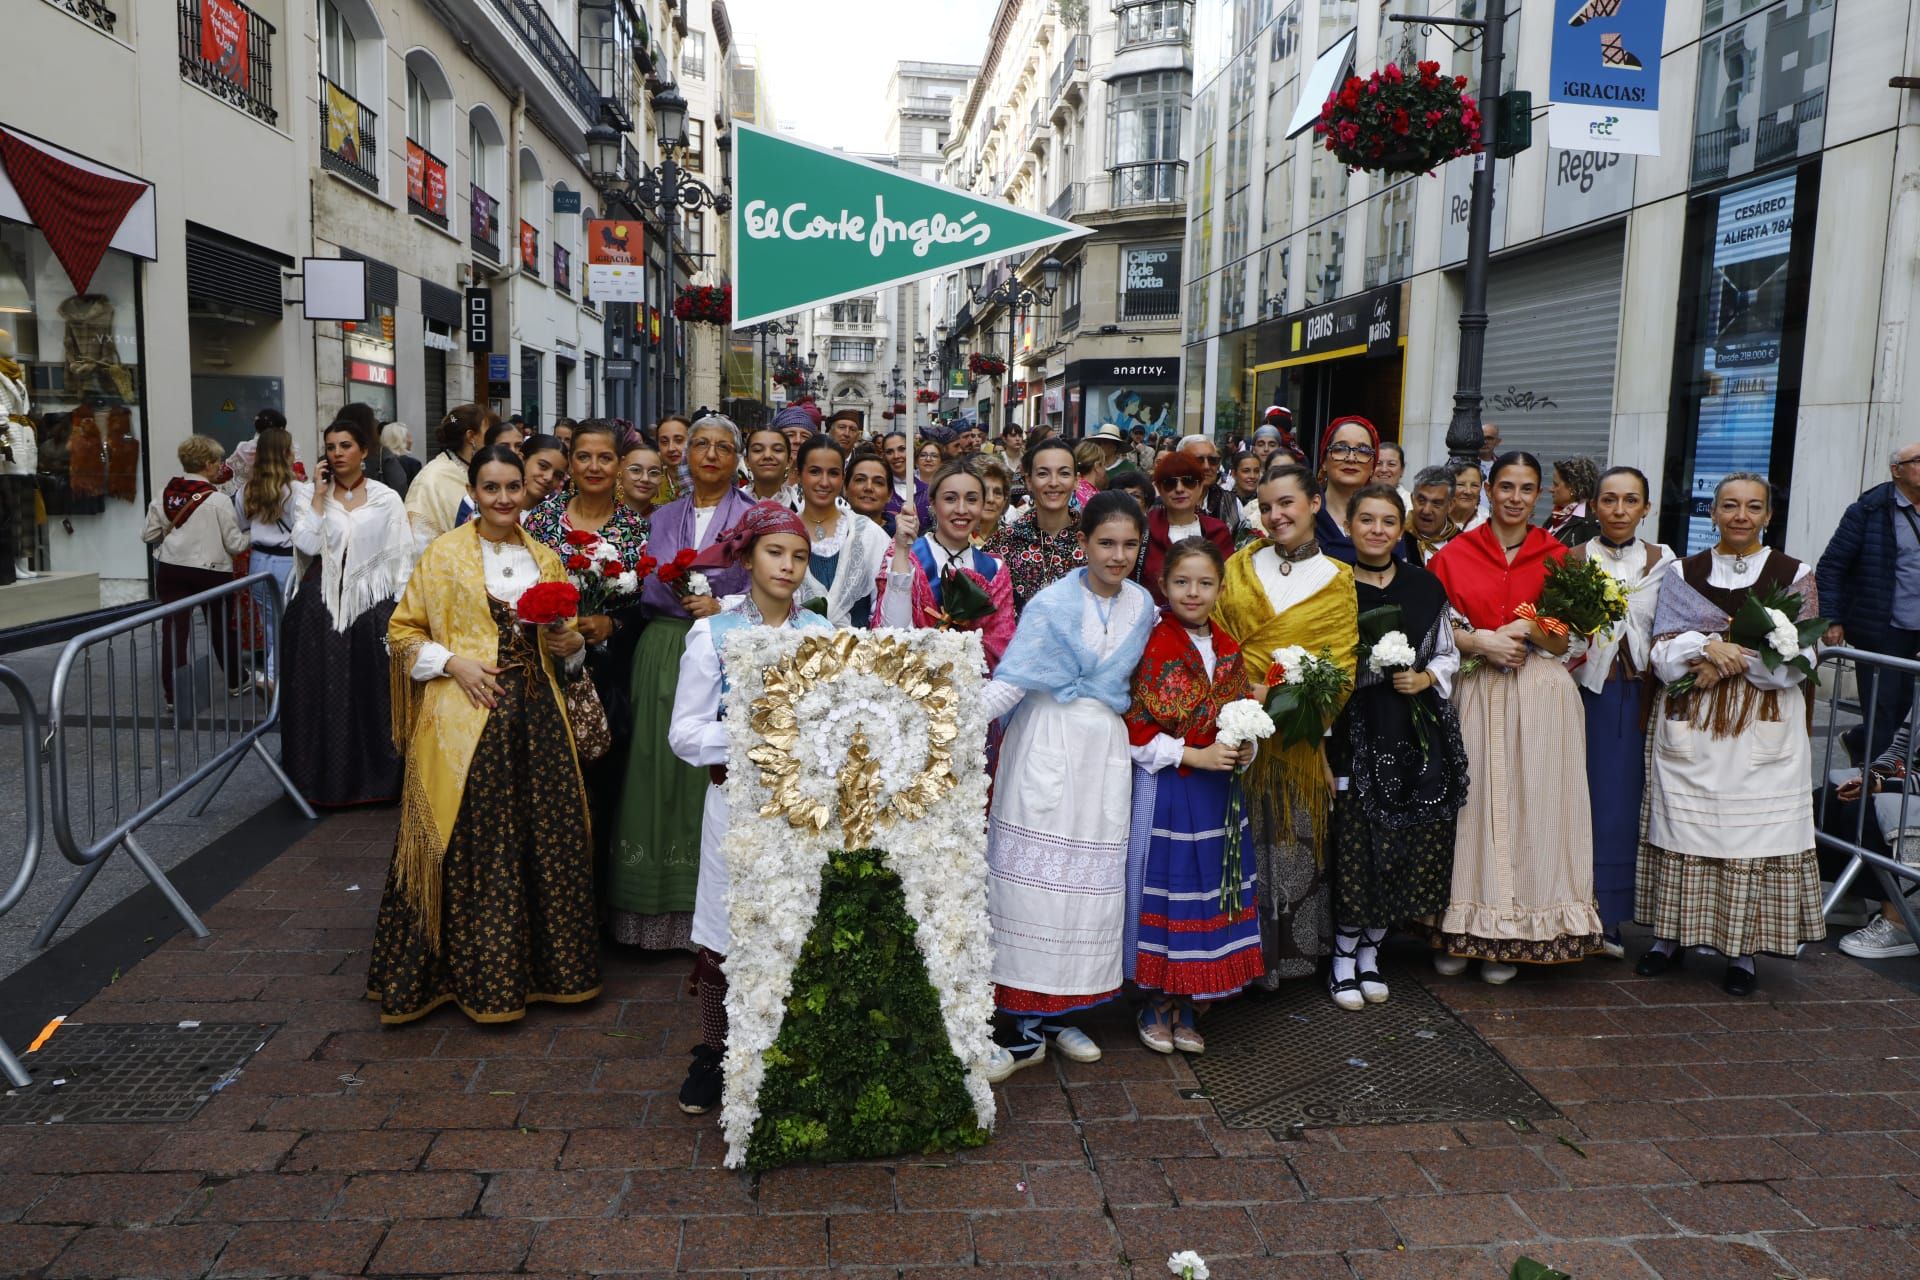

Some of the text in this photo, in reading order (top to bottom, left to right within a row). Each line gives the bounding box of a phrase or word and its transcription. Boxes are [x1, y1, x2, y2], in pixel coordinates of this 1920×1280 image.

[1563, 81, 1646, 103] ¡GRACIAS!
[1590, 121, 1614, 135] FCC
[1735, 196, 1786, 221] CESÁREO
[744, 194, 991, 257] El Corte Inglés
[1723, 223, 1768, 246] ALIERTA
[1127, 276, 1163, 289] Motta
[1306, 312, 1334, 349] pans
[1368, 320, 1391, 348] pans
[1717, 352, 1739, 363] Desde
[1113, 365, 1166, 377] anartxy.
